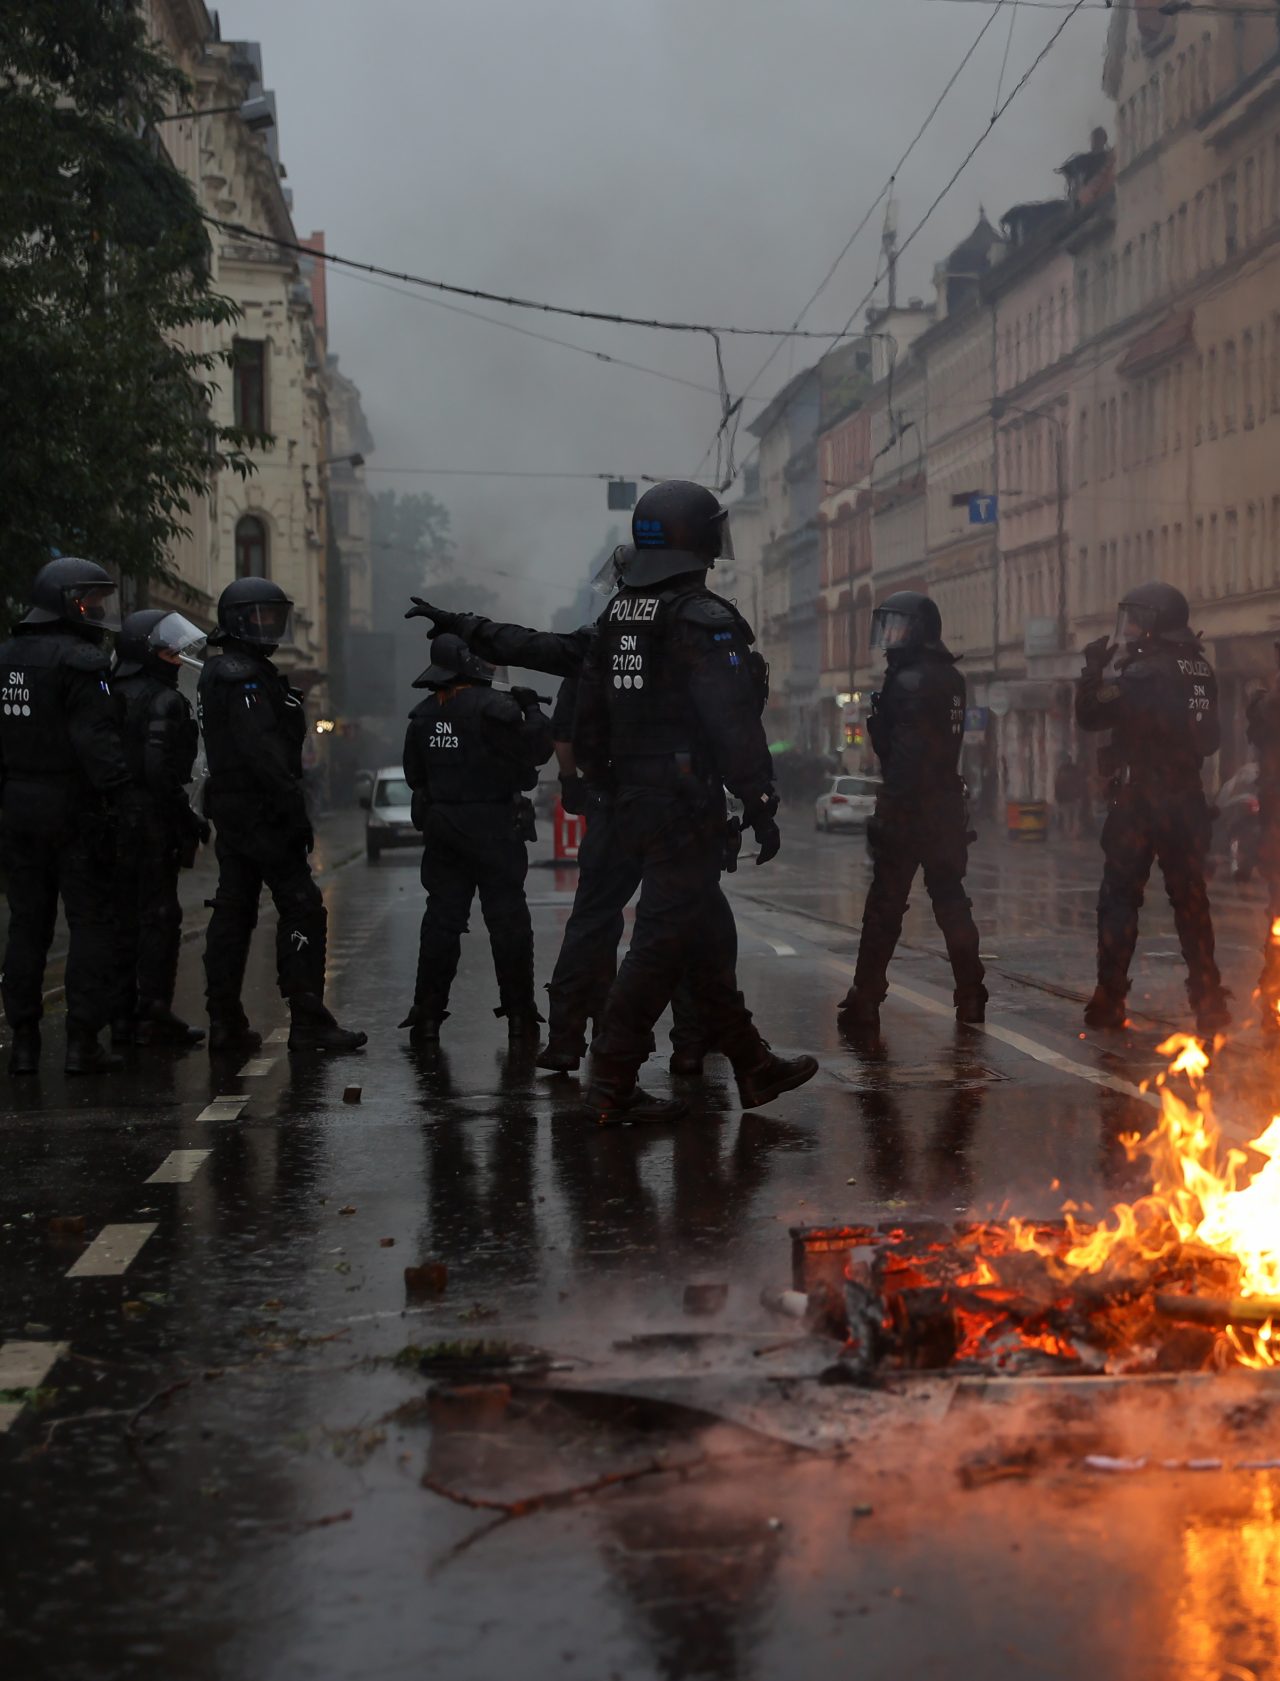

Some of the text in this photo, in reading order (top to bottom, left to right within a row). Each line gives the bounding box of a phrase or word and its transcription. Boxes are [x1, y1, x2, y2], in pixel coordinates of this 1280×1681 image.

[608, 598, 660, 621] POLIZEI
[620, 635, 638, 651] SN
[612, 653, 643, 672] 21/20
[8, 671, 25, 685] SN
[1, 687, 31, 702] 21/10
[1193, 684, 1206, 696] SN
[435, 721, 453, 734] SN
[429, 735, 460, 749] 21/23
